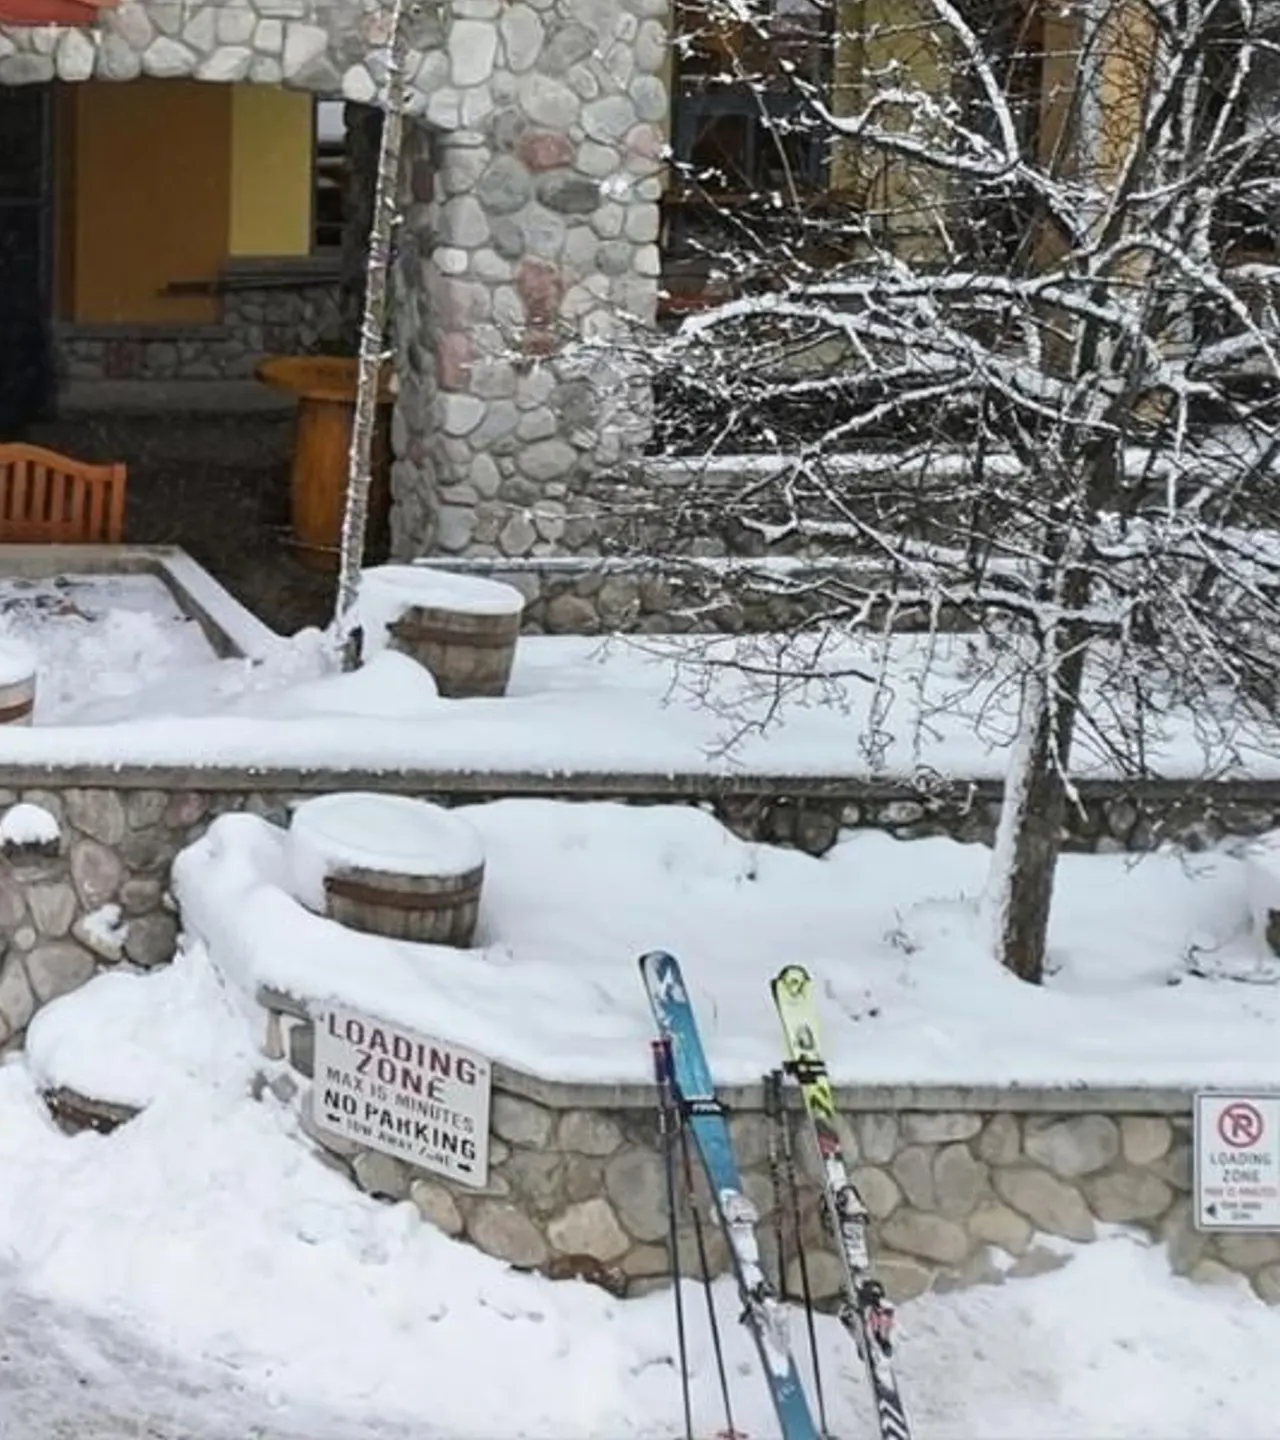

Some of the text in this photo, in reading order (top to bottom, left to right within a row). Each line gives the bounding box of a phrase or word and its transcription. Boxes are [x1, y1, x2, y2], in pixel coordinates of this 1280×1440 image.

[329, 1012, 476, 1086] LOADING
[356, 1049, 446, 1103] ZONE
[324, 1088, 476, 1160] NO PARKING
[327, 1066, 474, 1134] MAX 15 MINUTES
[1210, 1152, 1272, 1165] LOADING
[1222, 1169, 1260, 1183] ZONE
